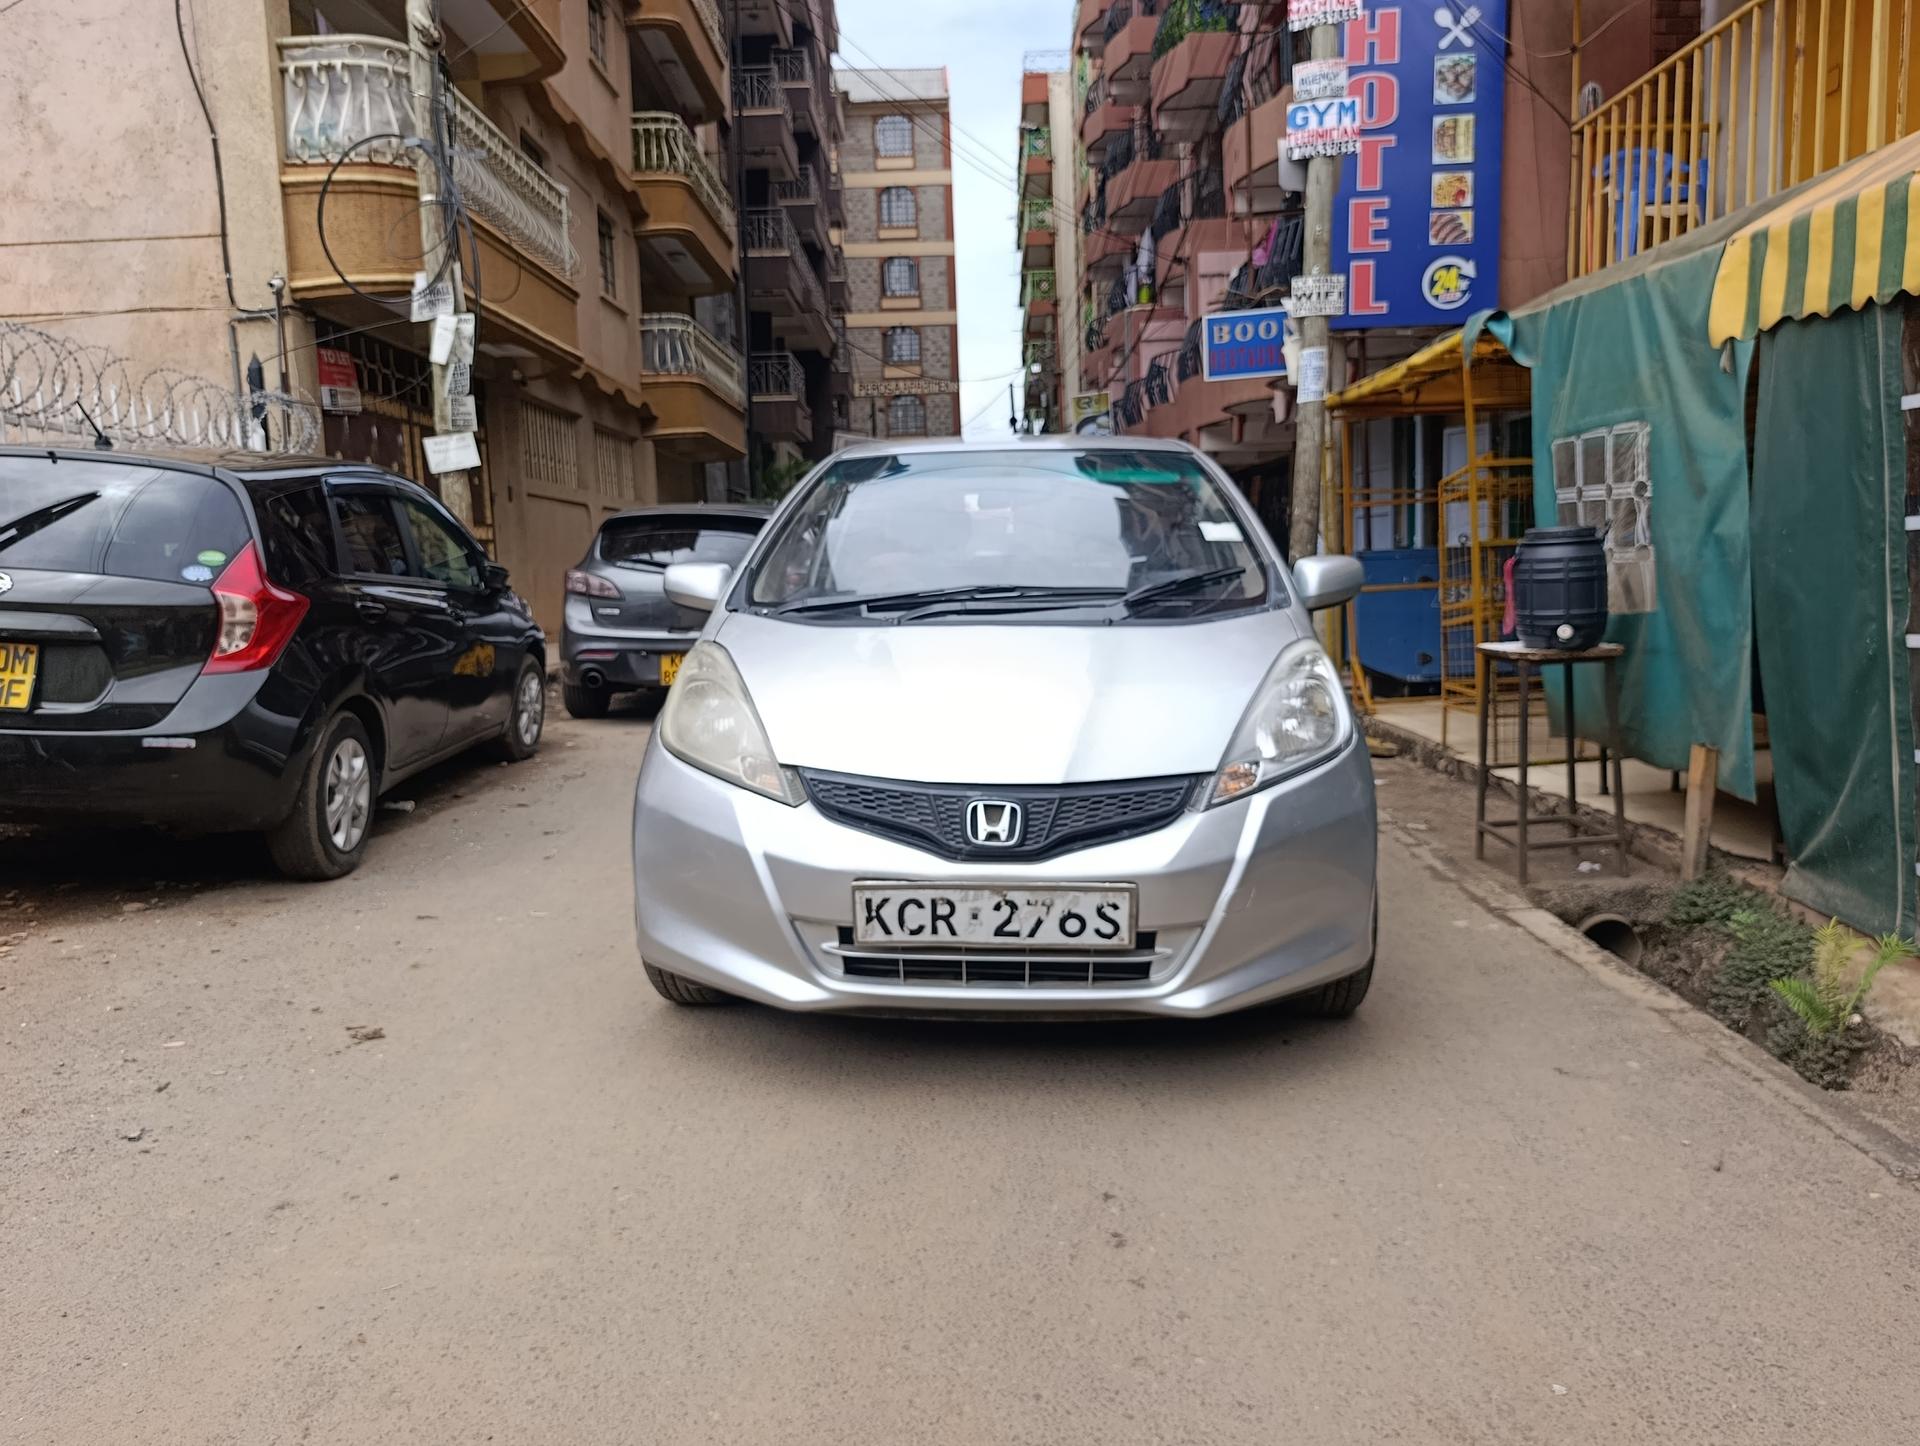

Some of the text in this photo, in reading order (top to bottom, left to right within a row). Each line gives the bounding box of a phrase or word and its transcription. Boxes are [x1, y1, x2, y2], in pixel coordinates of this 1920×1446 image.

[1287, 100, 1356, 129] GYM
[1344, 8, 1400, 315] HOTEL
[1293, 291, 1343, 301] WIFI
[1431, 266, 1458, 296] 24
[865, 896, 1121, 940] KCR 276S
